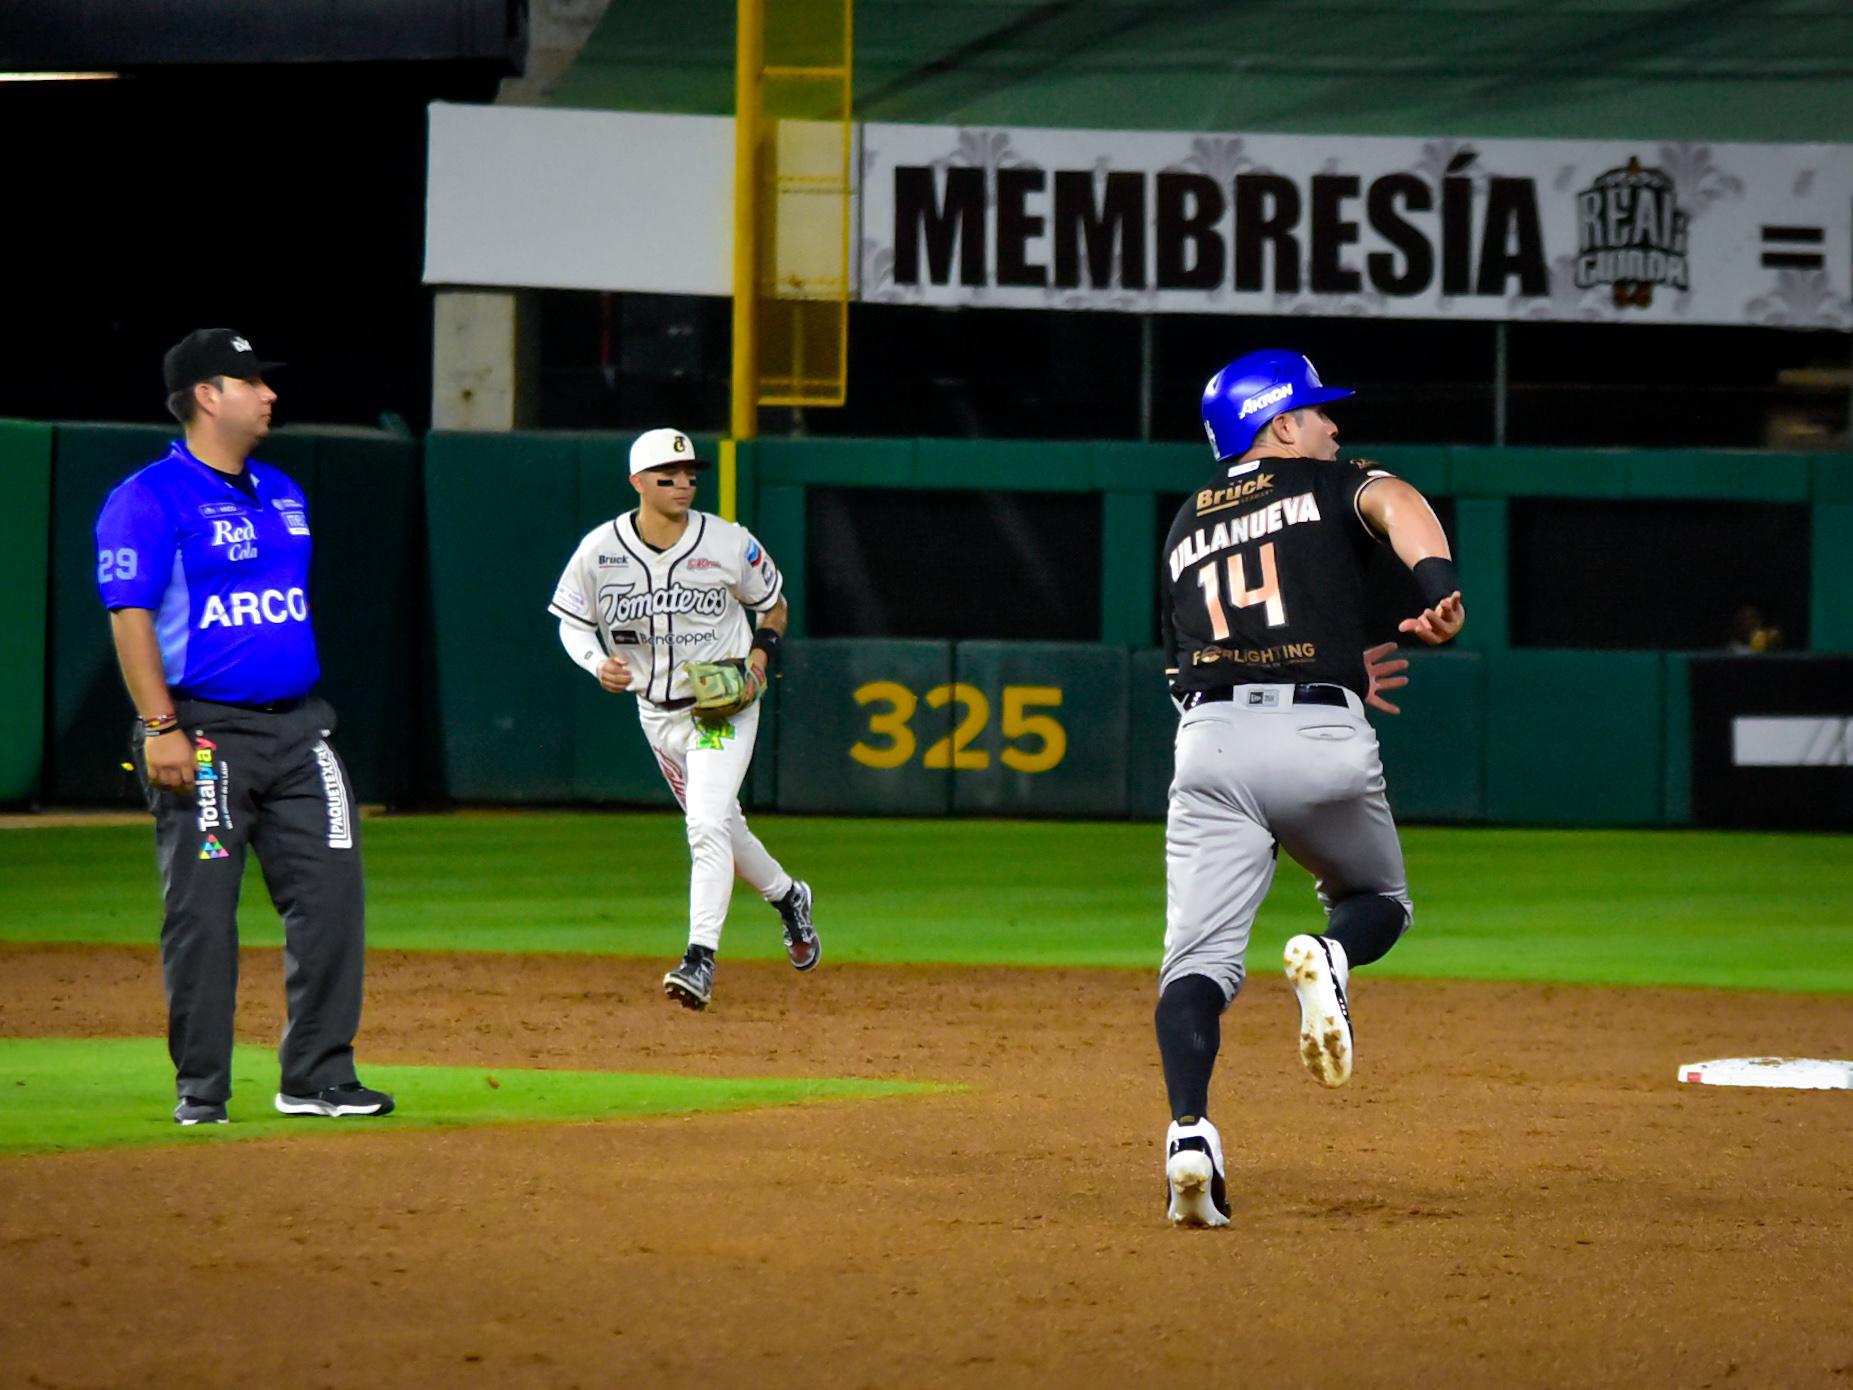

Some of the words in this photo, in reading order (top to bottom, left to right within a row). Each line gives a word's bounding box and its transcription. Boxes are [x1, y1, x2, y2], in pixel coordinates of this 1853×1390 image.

[893, 152, 1549, 298] MEMBRESÍA
[1238, 382, 1294, 420] AKRON
[211, 516, 258, 547] Red
[227, 541, 258, 562] Cola
[1168, 491, 1322, 584] VILLANUEVA
[97, 547, 138, 584] 29
[199, 587, 307, 630] ARCO
[599, 581, 726, 626] Tomateros
[1197, 541, 1288, 641] 14
[849, 680, 1067, 774] 325
